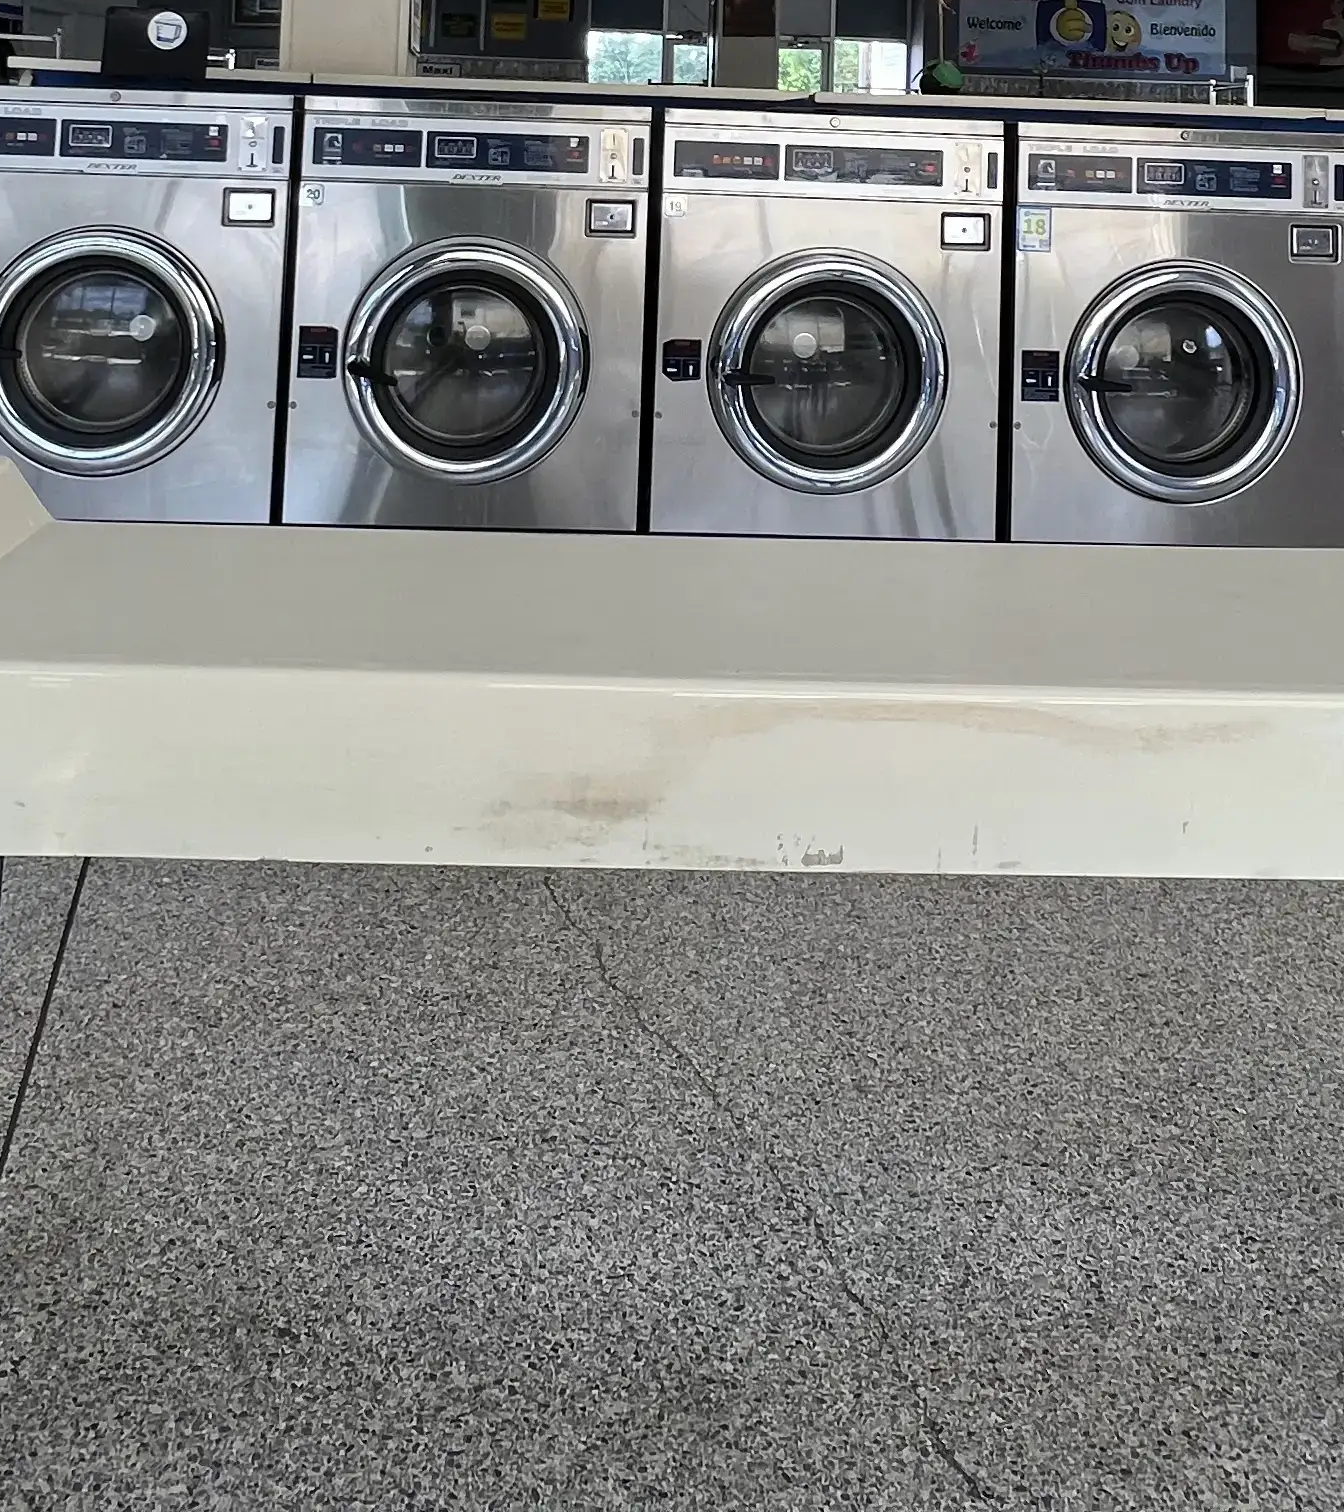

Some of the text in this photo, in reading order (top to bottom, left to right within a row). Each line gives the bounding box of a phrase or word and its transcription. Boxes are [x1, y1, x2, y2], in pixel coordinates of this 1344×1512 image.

[967, 16, 1023, 31] Welcome
[1068, 50, 1200, 76] Thumbs Up
[87, 162, 138, 172] DEXTER
[452, 173, 502, 182] DEXTER
[306, 189, 321, 200] 20
[669, 201, 682, 213] 19
[1163, 199, 1210, 208] DEXTER
[1023, 218, 1047, 235] 18
